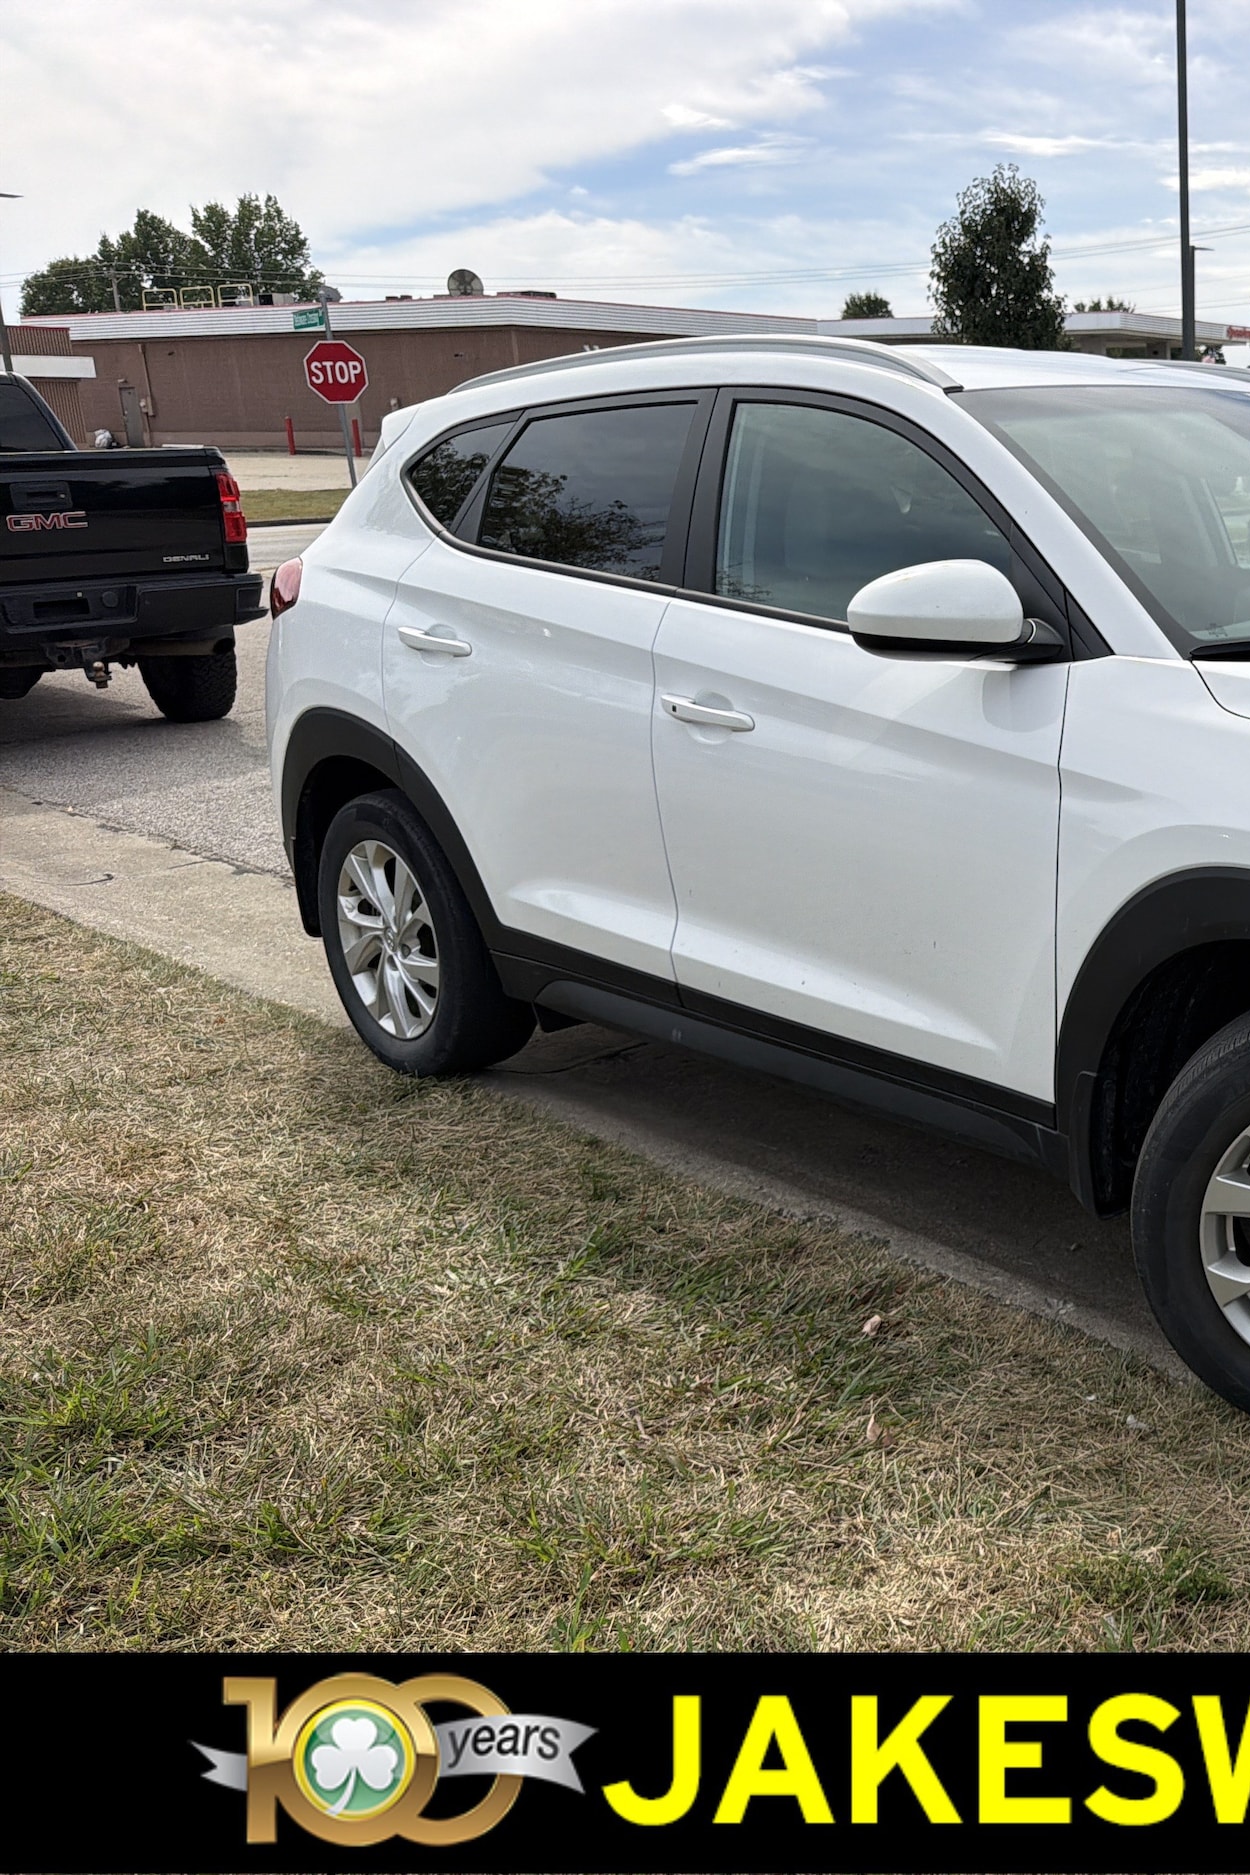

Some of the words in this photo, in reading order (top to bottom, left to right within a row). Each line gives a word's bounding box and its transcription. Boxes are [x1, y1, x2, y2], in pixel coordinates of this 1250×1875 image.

[310, 361, 362, 384] STOP
[6, 511, 88, 532] GMC
[162, 554, 210, 563] DENALI
